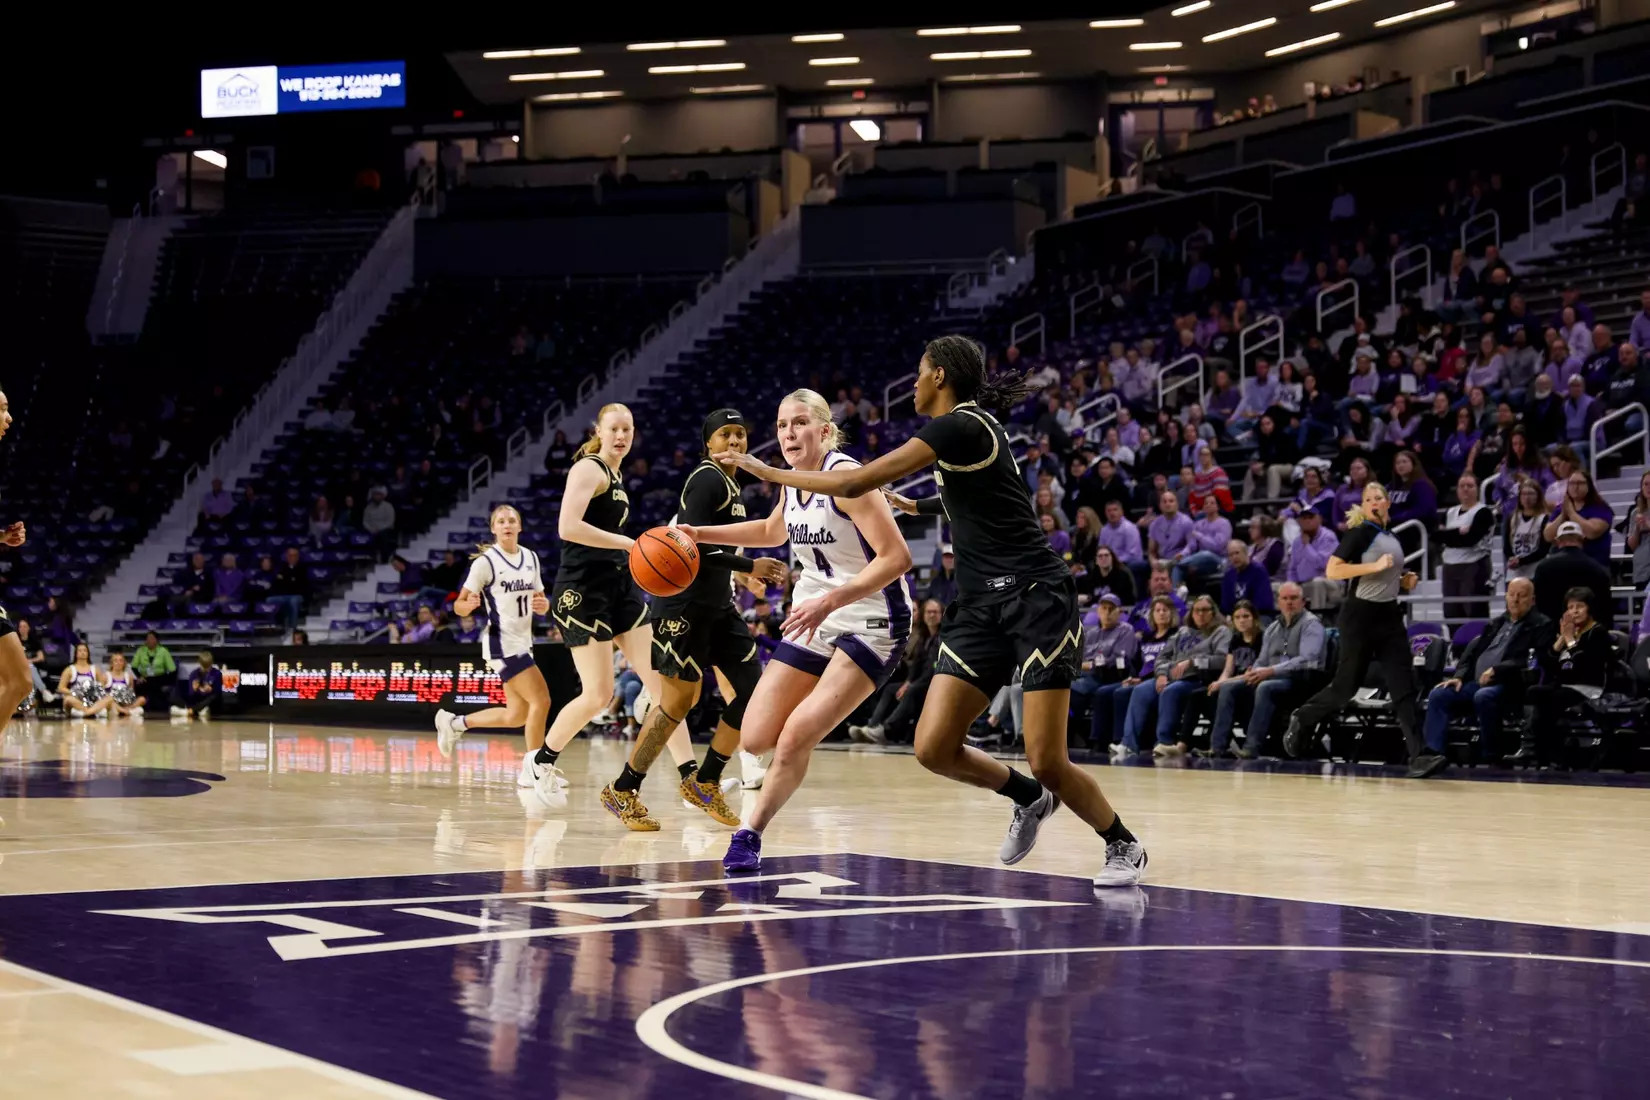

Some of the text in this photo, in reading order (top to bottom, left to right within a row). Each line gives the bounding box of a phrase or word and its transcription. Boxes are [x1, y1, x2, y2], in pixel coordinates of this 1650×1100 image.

[217, 85, 259, 98] BUCK
[280, 74, 400, 91] WE ROOF KANSAS
[787, 522, 837, 546] Wildcats
[811, 547, 836, 579] 4
[516, 594, 528, 618] 11
